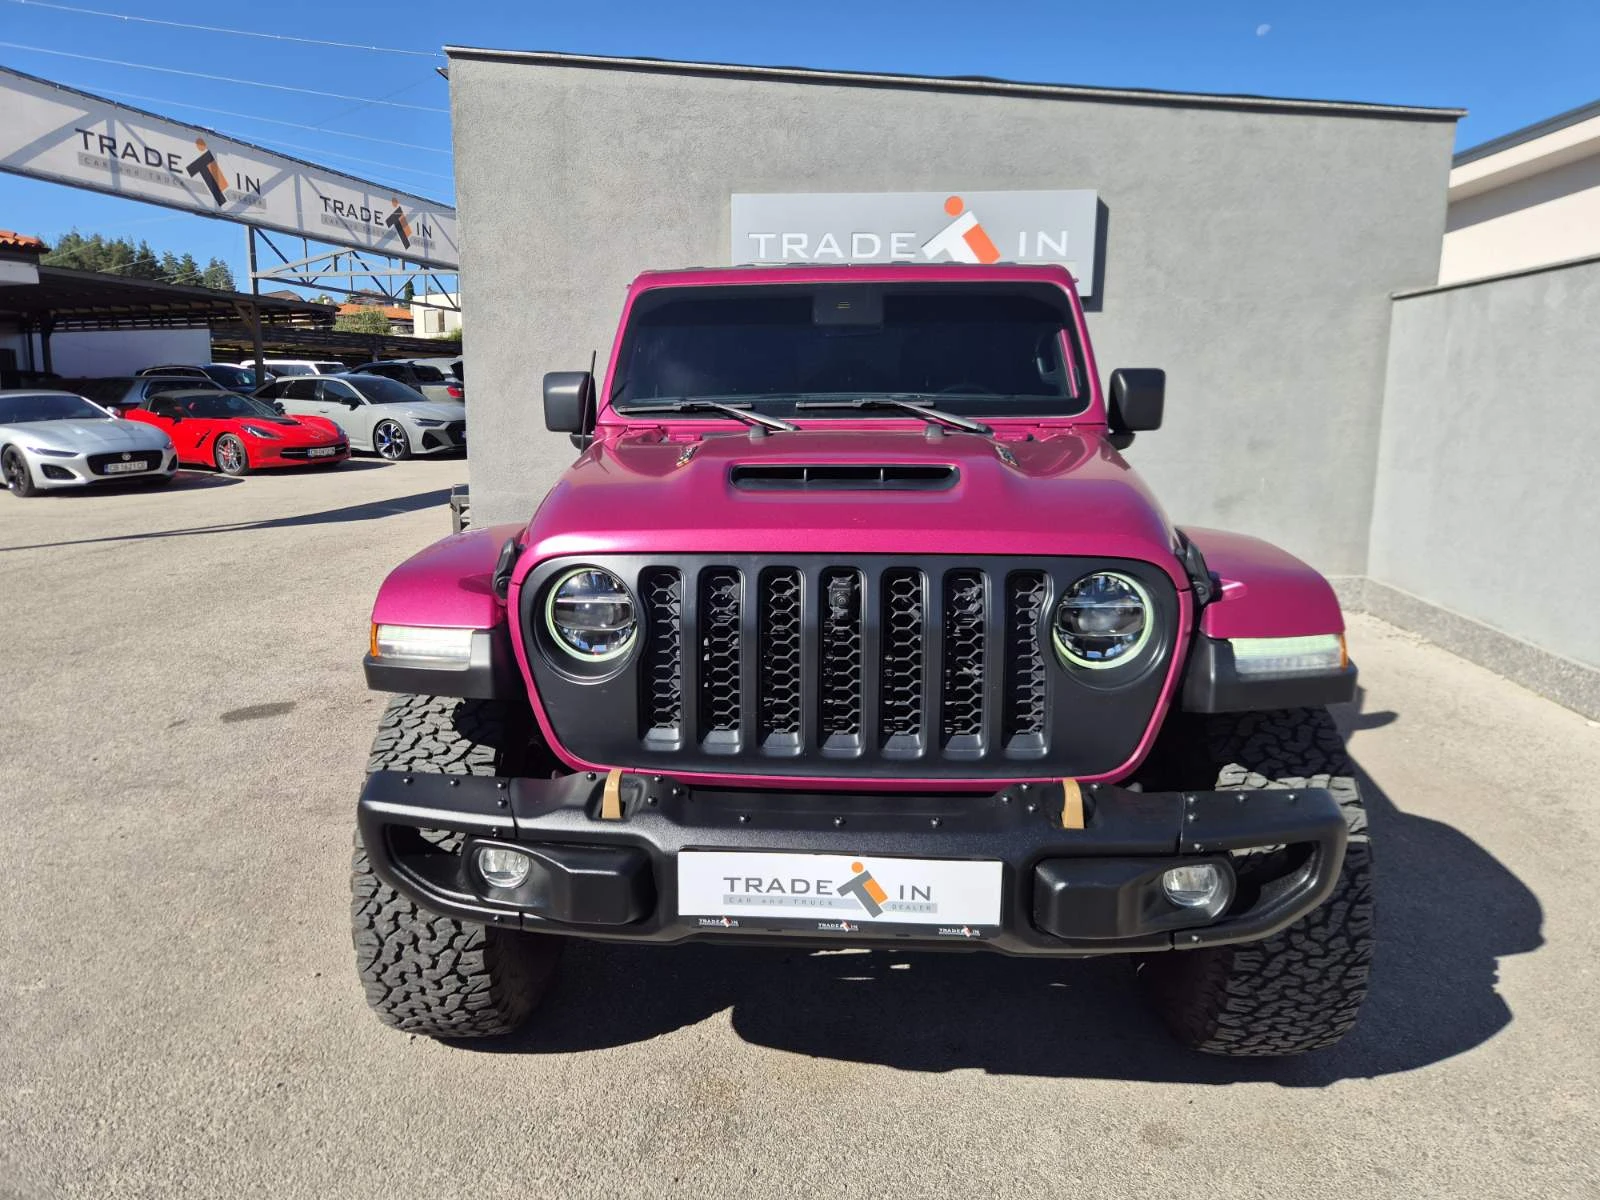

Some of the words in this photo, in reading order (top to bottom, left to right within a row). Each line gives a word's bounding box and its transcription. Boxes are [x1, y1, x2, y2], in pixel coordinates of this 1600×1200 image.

[75, 128, 184, 174] TRADE
[236, 172, 261, 196] IN
[320, 195, 384, 226] TRADE
[416, 221, 432, 239] IN
[748, 232, 917, 259] TRADE
[1018, 230, 1069, 257] IN
[723, 877, 833, 896] TRADE
[899, 884, 931, 901] IN
[728, 896, 752, 904] CAR
[793, 898, 834, 906] TRUCK
[891, 903, 932, 912] DEALER
[939, 927, 962, 935] TRADE
